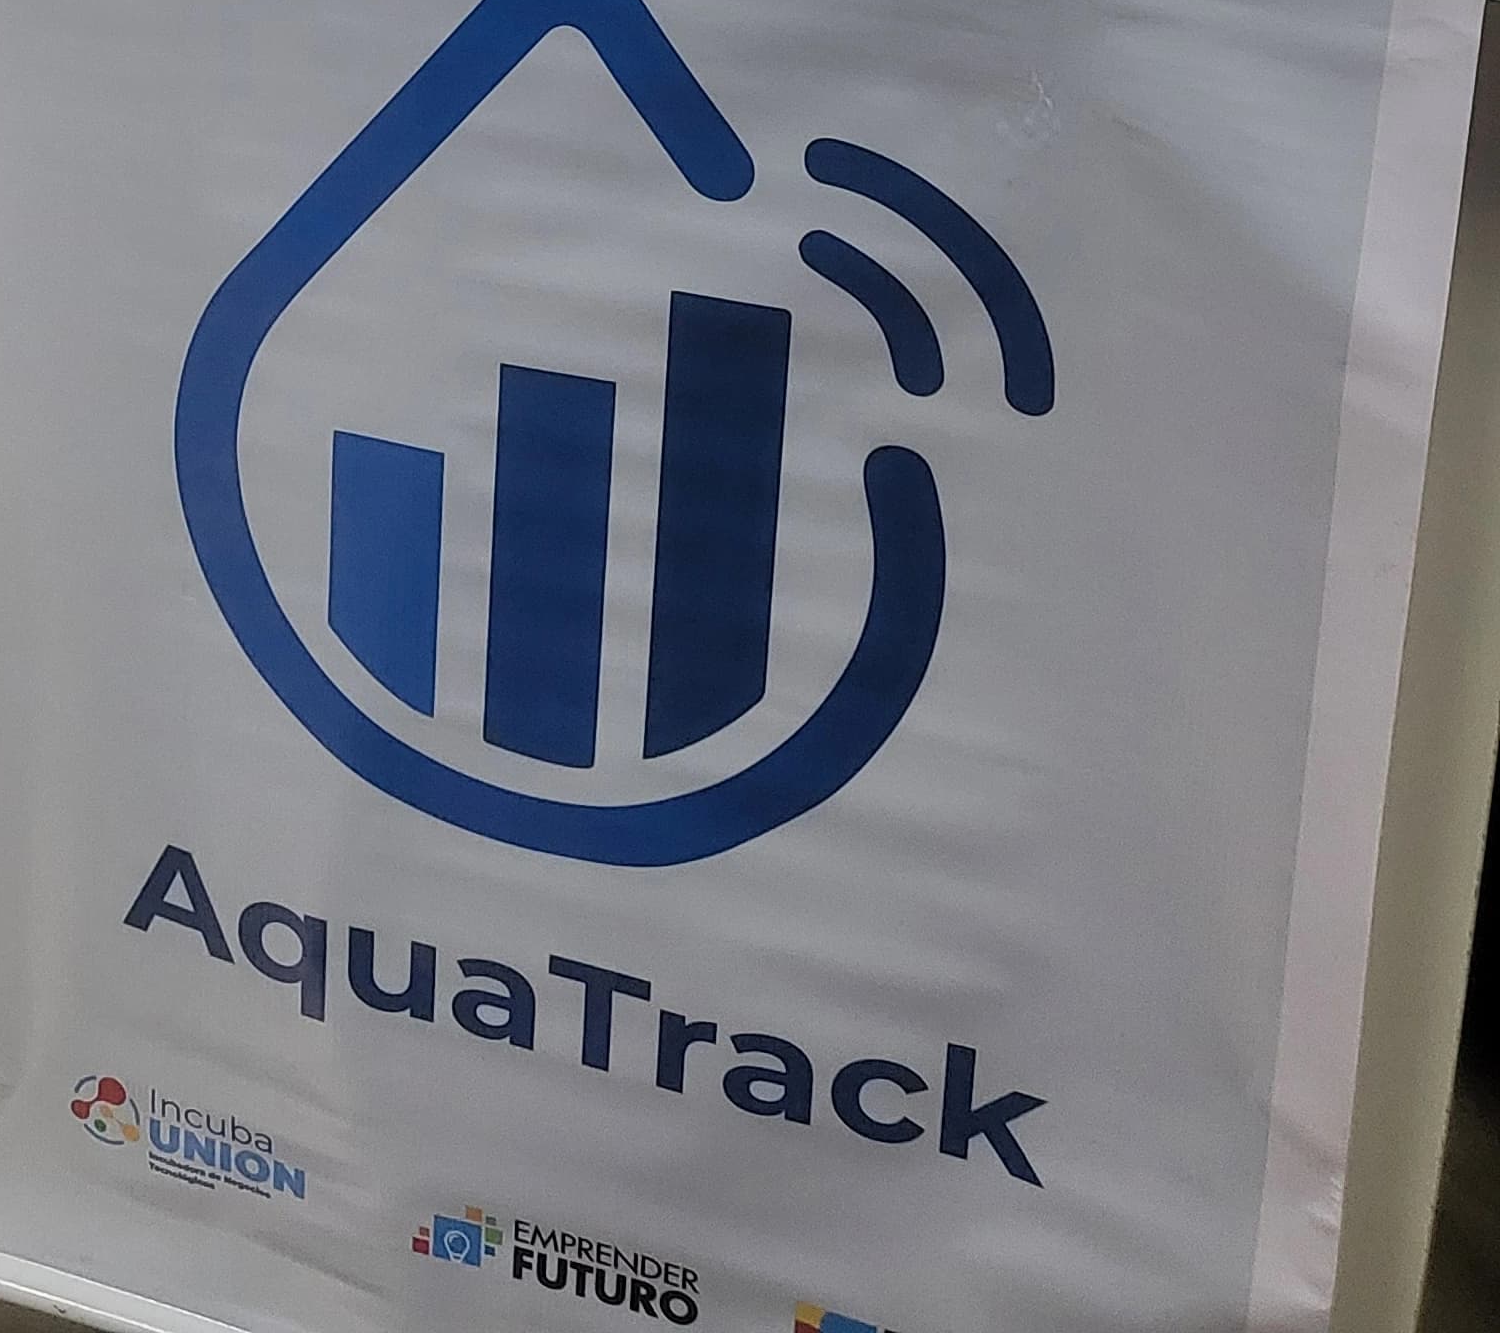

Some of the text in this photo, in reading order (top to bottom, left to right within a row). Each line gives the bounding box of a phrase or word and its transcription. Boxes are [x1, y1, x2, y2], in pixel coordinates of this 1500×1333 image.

[123, 844, 1047, 1188] AquaTrack
[150, 1117, 305, 1199] UNION
[151, 1089, 273, 1154] Incuba
[513, 1246, 698, 1325] FUTURO
[514, 1219, 699, 1293] EMPRENDER
